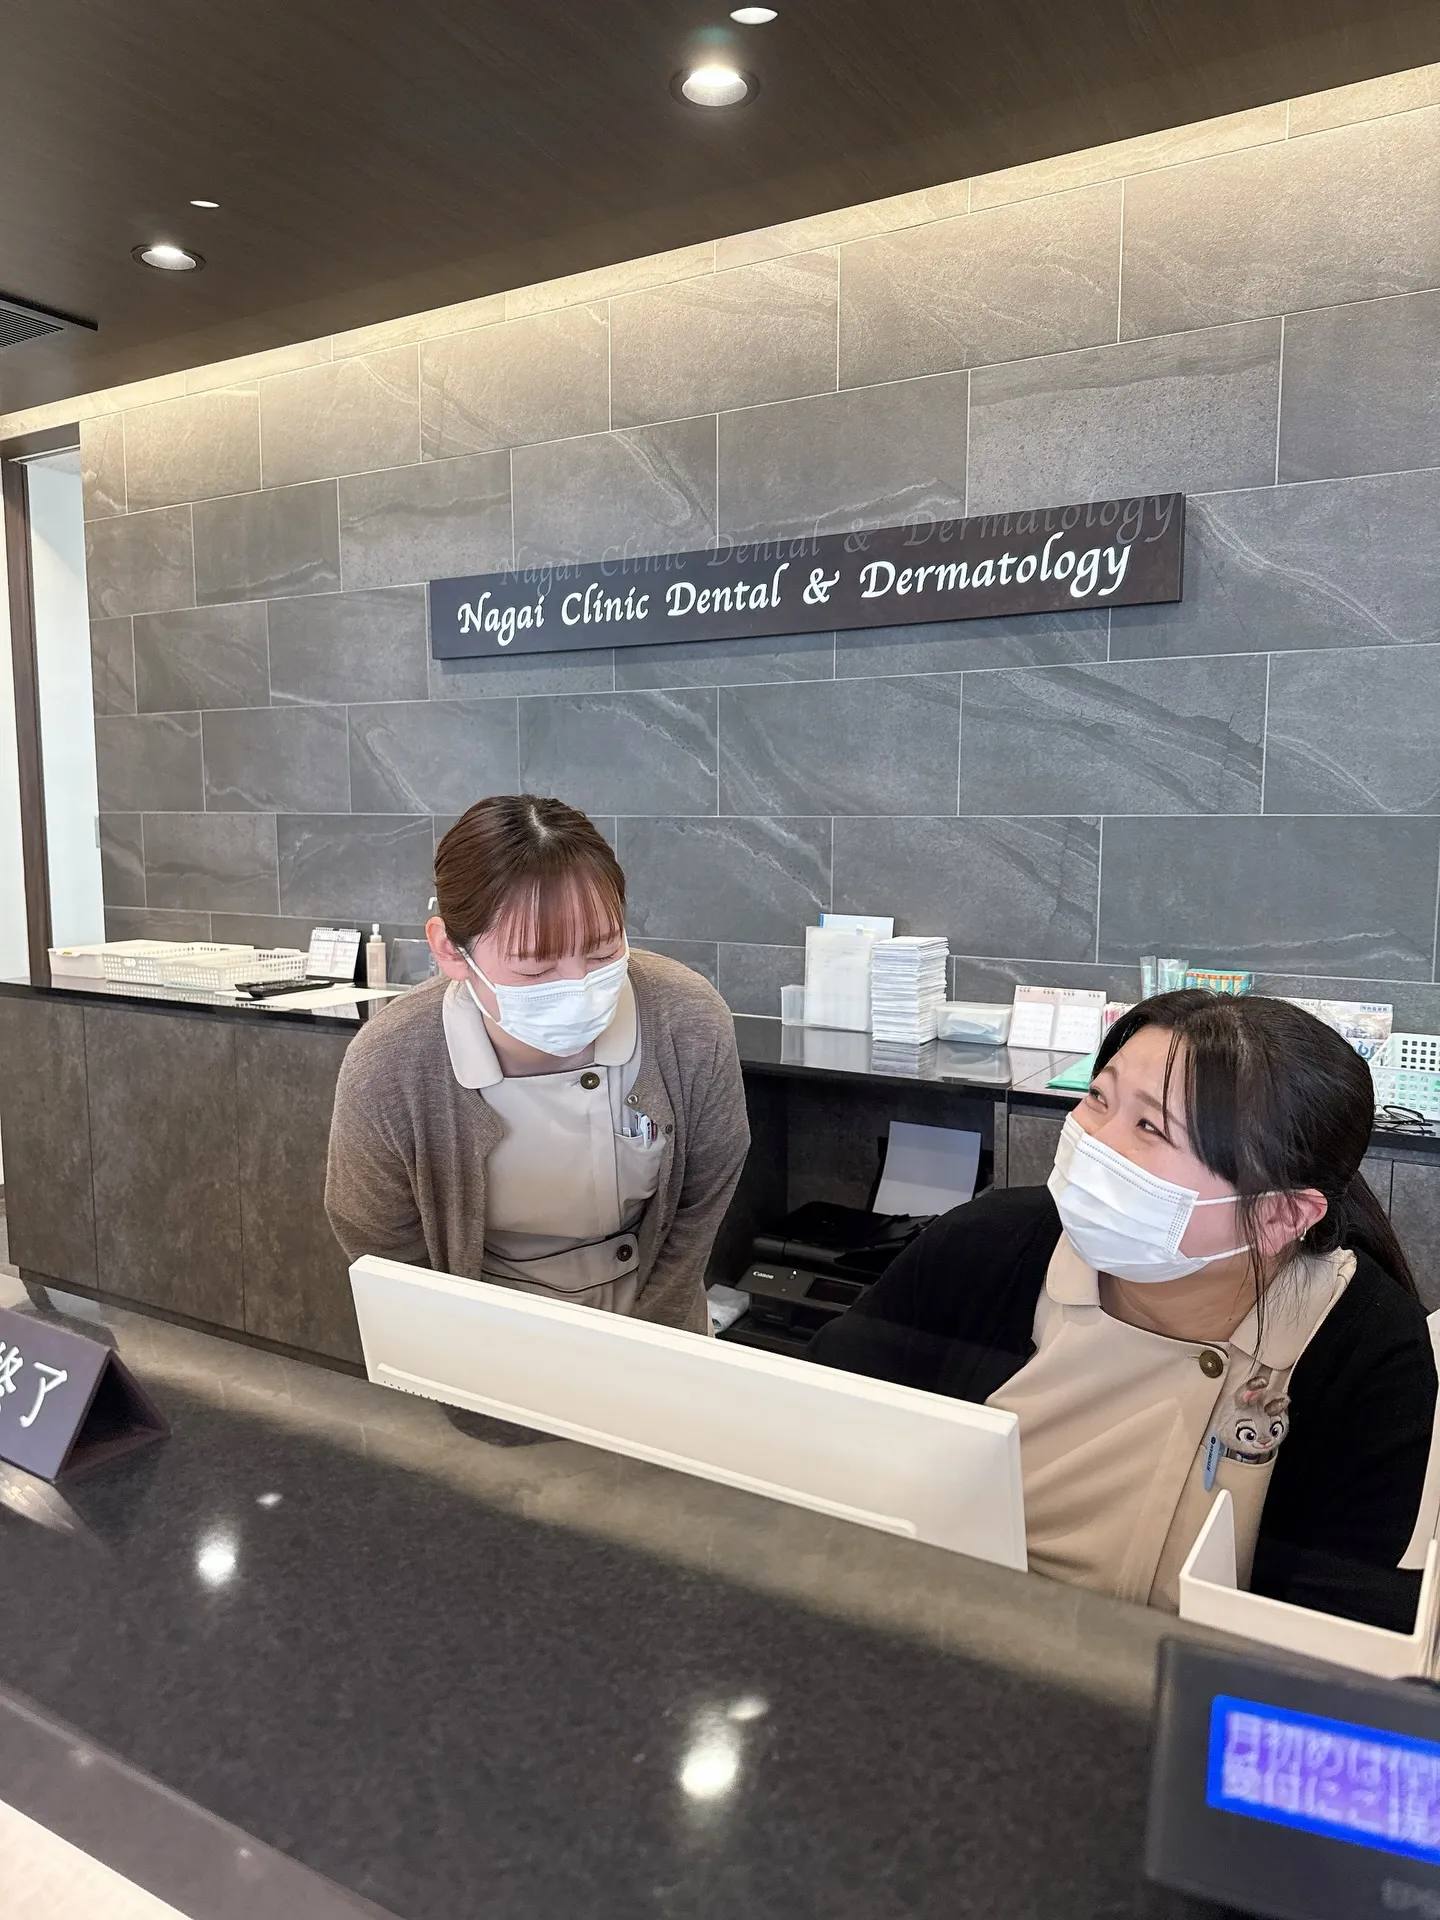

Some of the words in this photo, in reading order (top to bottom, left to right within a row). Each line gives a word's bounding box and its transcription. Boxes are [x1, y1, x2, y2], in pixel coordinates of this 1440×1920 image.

[457, 590, 546, 647] Nagai
[561, 582, 650, 626] Clinic
[665, 562, 790, 616] Dental
[802, 567, 840, 605] &
[859, 531, 1132, 598] Dermatology
[600, 532, 687, 577] Clinic
[704, 513, 821, 567] Dental
[843, 517, 882, 553] &
